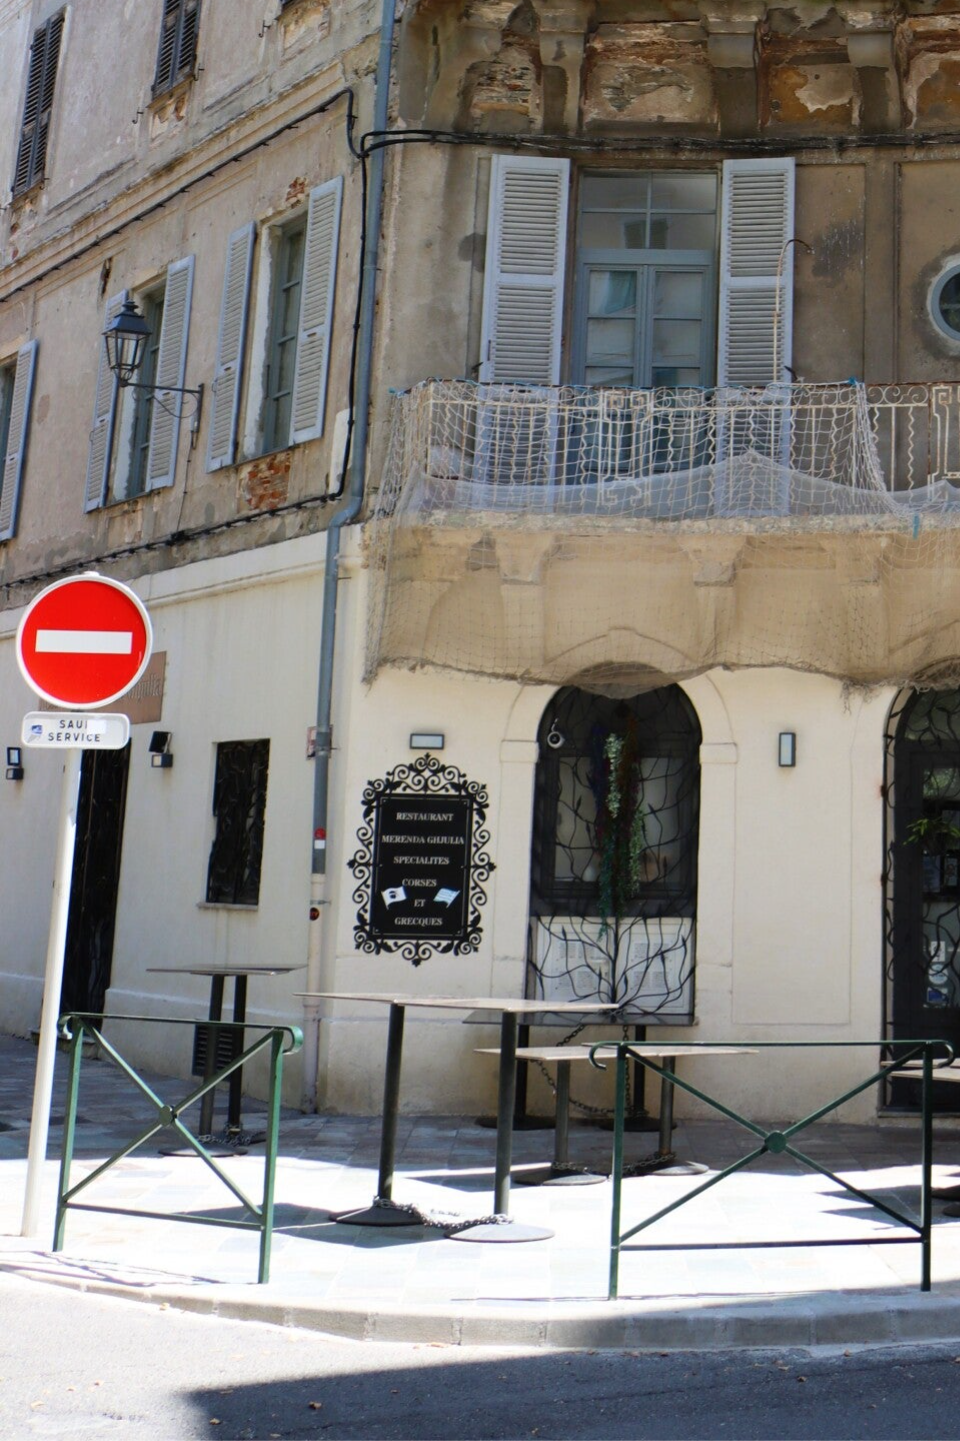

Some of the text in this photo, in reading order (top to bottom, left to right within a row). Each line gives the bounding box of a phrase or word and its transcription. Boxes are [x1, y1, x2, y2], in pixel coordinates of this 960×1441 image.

[59, 720, 88, 729] SAU
[48, 733, 101, 742] SERVICE
[396, 812, 453, 821] RESTAURANT
[381, 834, 465, 845] MERENDA GHJULIA
[393, 856, 450, 865] SPECIALITES
[402, 878, 437, 887] CORSES
[413, 899, 426, 908] ET
[394, 916, 443, 927] GRECQUES
